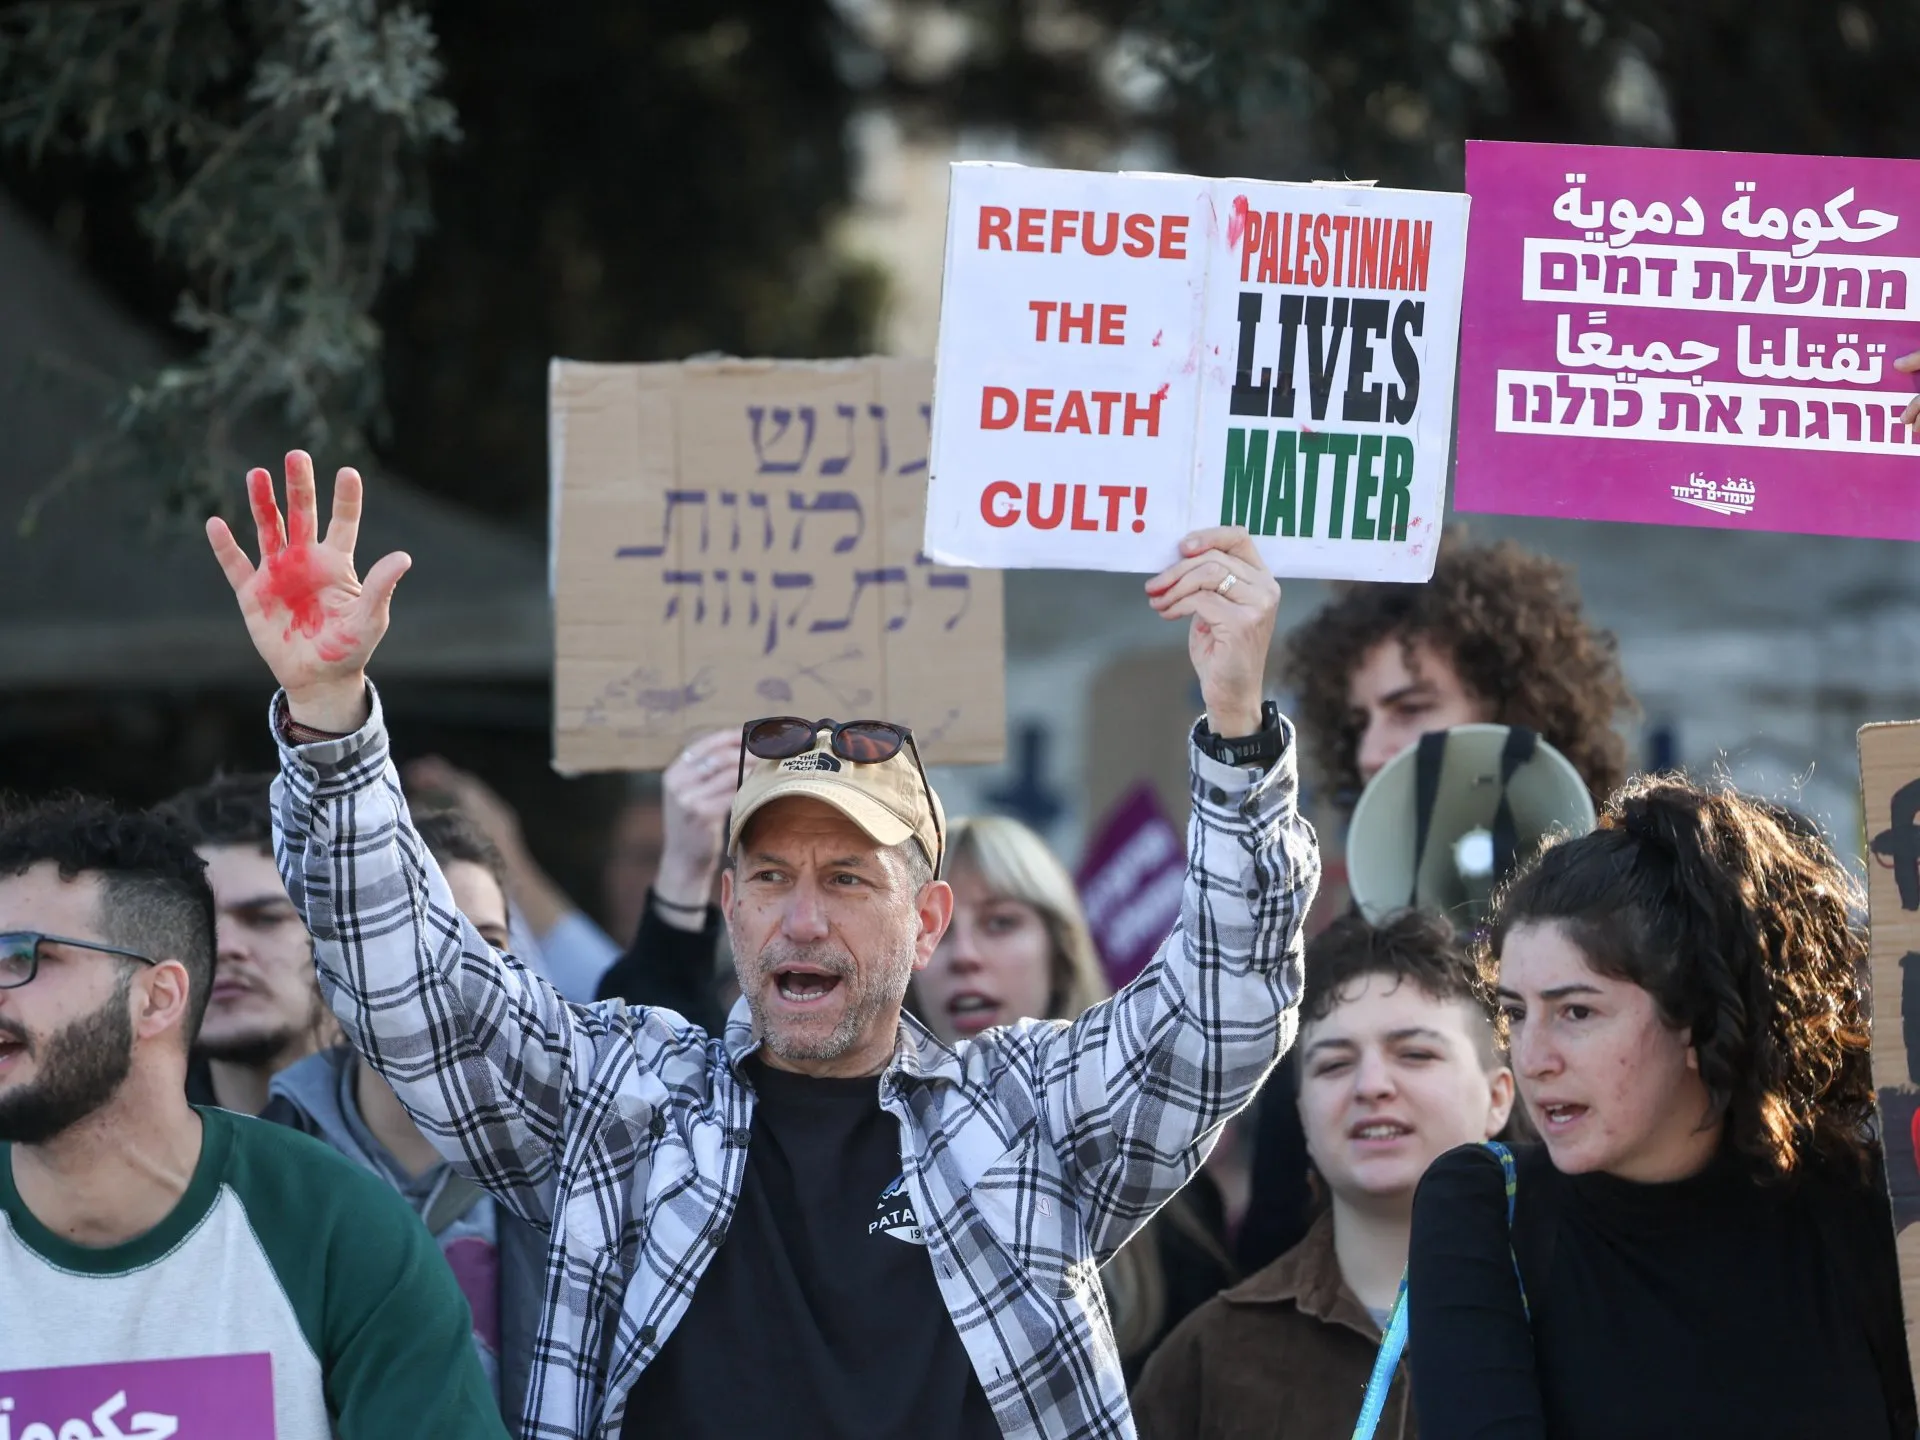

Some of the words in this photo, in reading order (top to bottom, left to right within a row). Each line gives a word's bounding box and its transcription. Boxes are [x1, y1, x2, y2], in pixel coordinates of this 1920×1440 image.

[977, 206, 1189, 259] REFUSE
[1553, 173, 1705, 248] دموية
[1722, 181, 1899, 257] حكومة
[1240, 209, 1433, 292] PALESTINIAN
[1540, 251, 1677, 297] דמים
[1692, 252, 1907, 310] ממשלת
[1028, 300, 1127, 346] THE
[1229, 291, 1426, 426] LIVES
[1737, 324, 1886, 385] تقتلنا
[979, 385, 1162, 437] DEATH
[1508, 374, 1643, 427] כולנו
[1658, 391, 1743, 434] את
[979, 480, 1148, 533] CULT!
[1219, 428, 1415, 542] MATTER
[1670, 485, 1702, 499] ביחד
[1706, 489, 1755, 504] עומדים
[1721, 477, 1755, 493] نقف
[614, 489, 866, 559] מוות
[662, 551, 971, 656] לתקווה
[799, 753, 817, 761] THE
[868, 1208, 916, 1235] PATA
